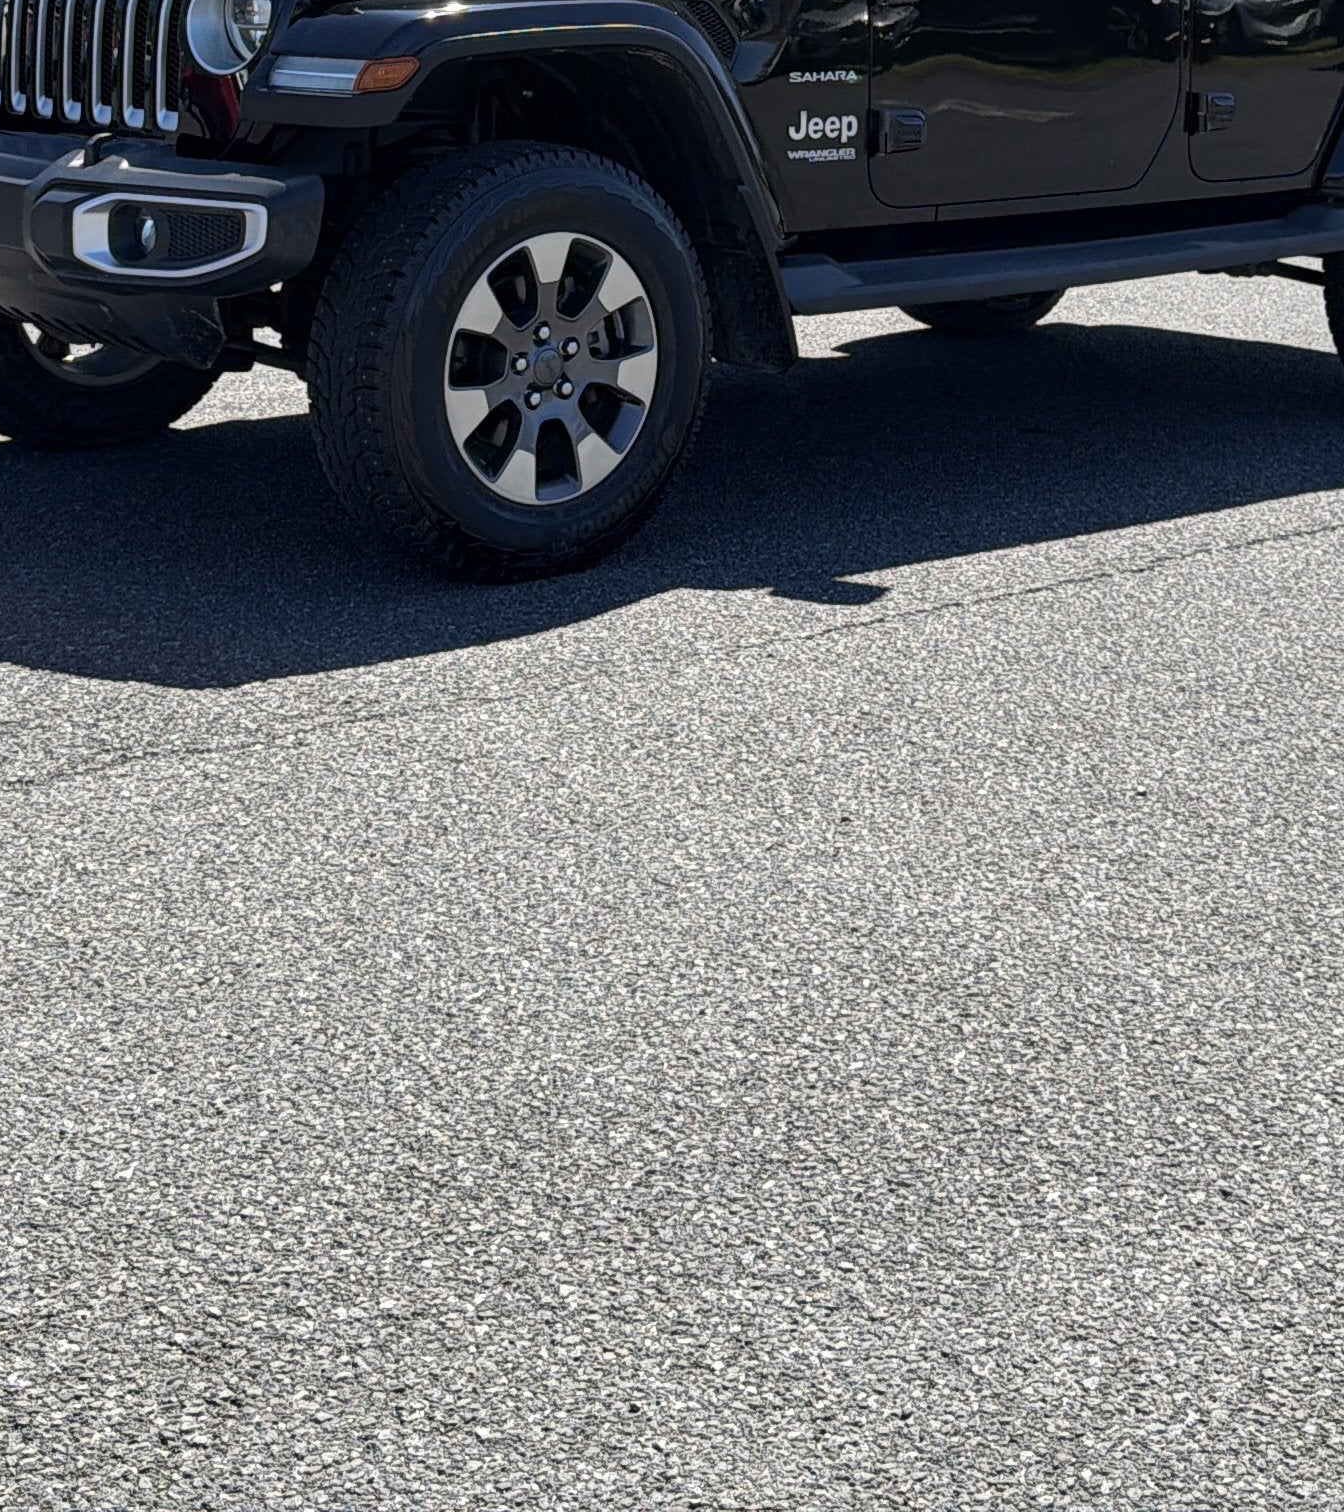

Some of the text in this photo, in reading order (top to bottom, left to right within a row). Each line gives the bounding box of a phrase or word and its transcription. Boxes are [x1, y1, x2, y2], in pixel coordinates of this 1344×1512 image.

[788, 70, 859, 83] SAHARA
[788, 110, 859, 144] Jeep
[787, 148, 857, 160] WRANGLER
